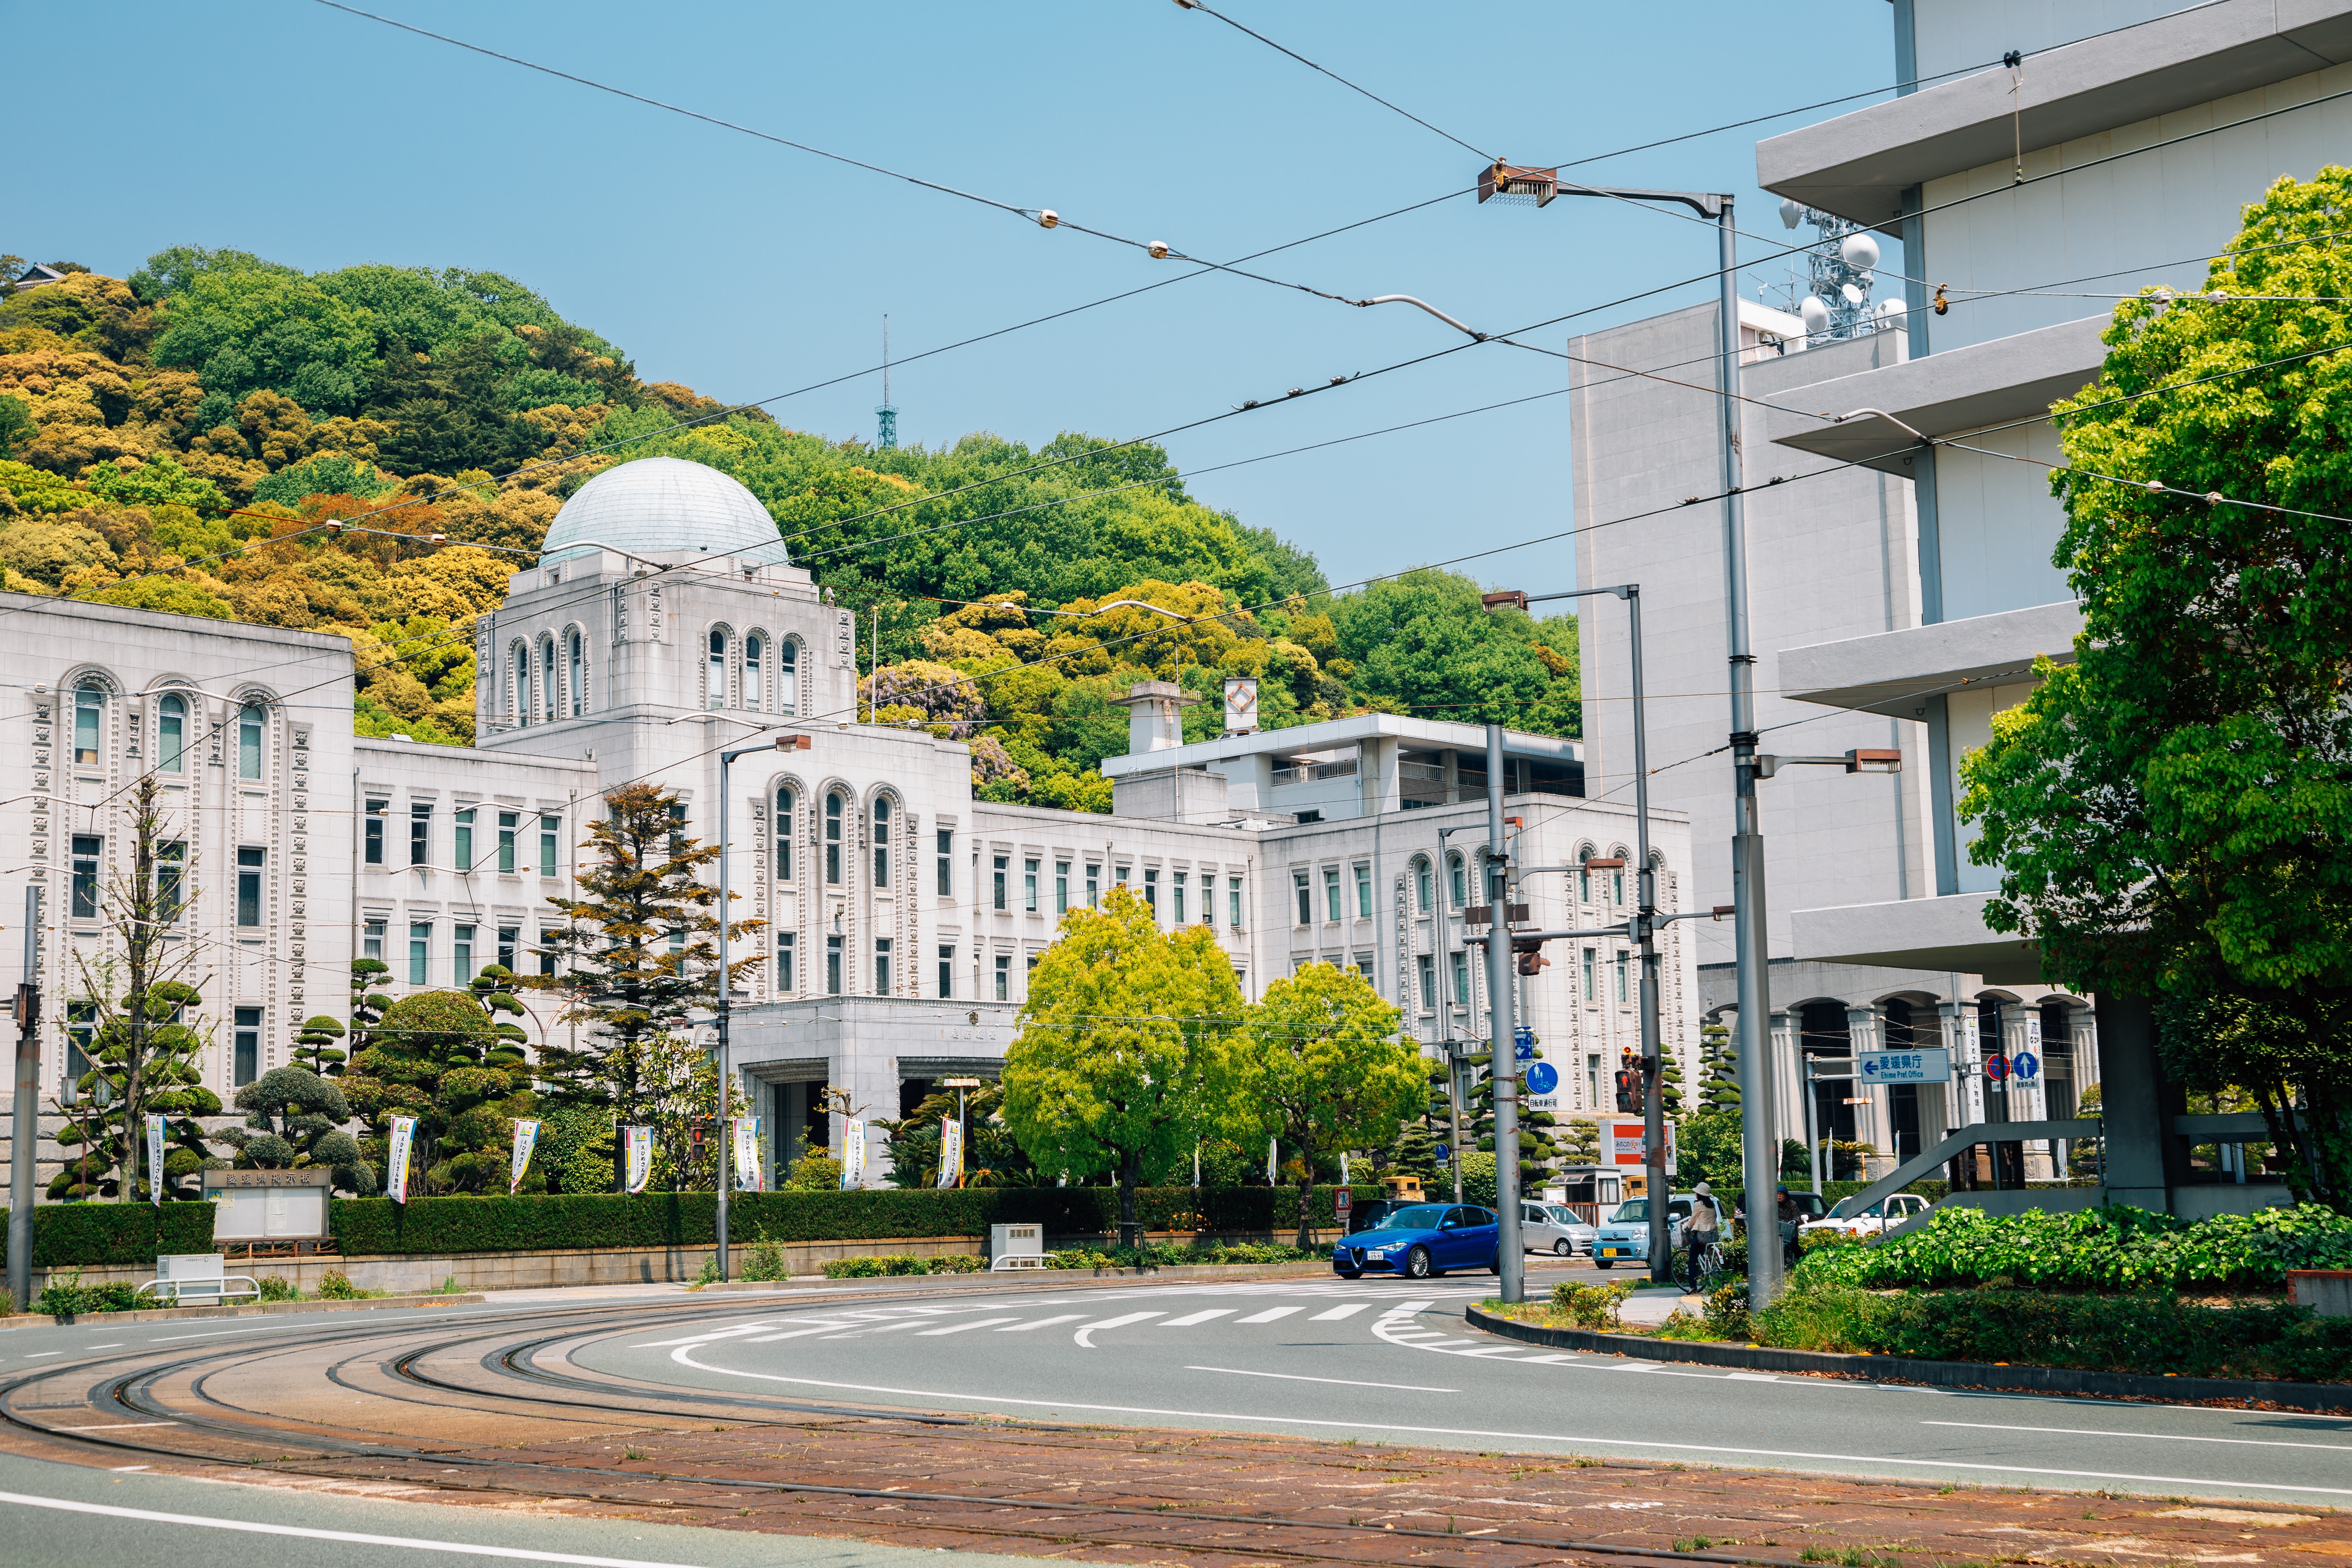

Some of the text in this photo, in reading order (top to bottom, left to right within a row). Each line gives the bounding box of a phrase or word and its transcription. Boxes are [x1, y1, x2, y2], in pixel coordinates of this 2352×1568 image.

[1880, 1055, 1922, 1069] 愛媛県庁
[227, 1173, 311, 1184] 愛媛県掲示板
[394, 1136, 405, 1189] えひめさんさん物語
[746, 1135, 754, 1181] えひめさんさん物語
[947, 1137, 957, 1182] えひめさんさん物語
